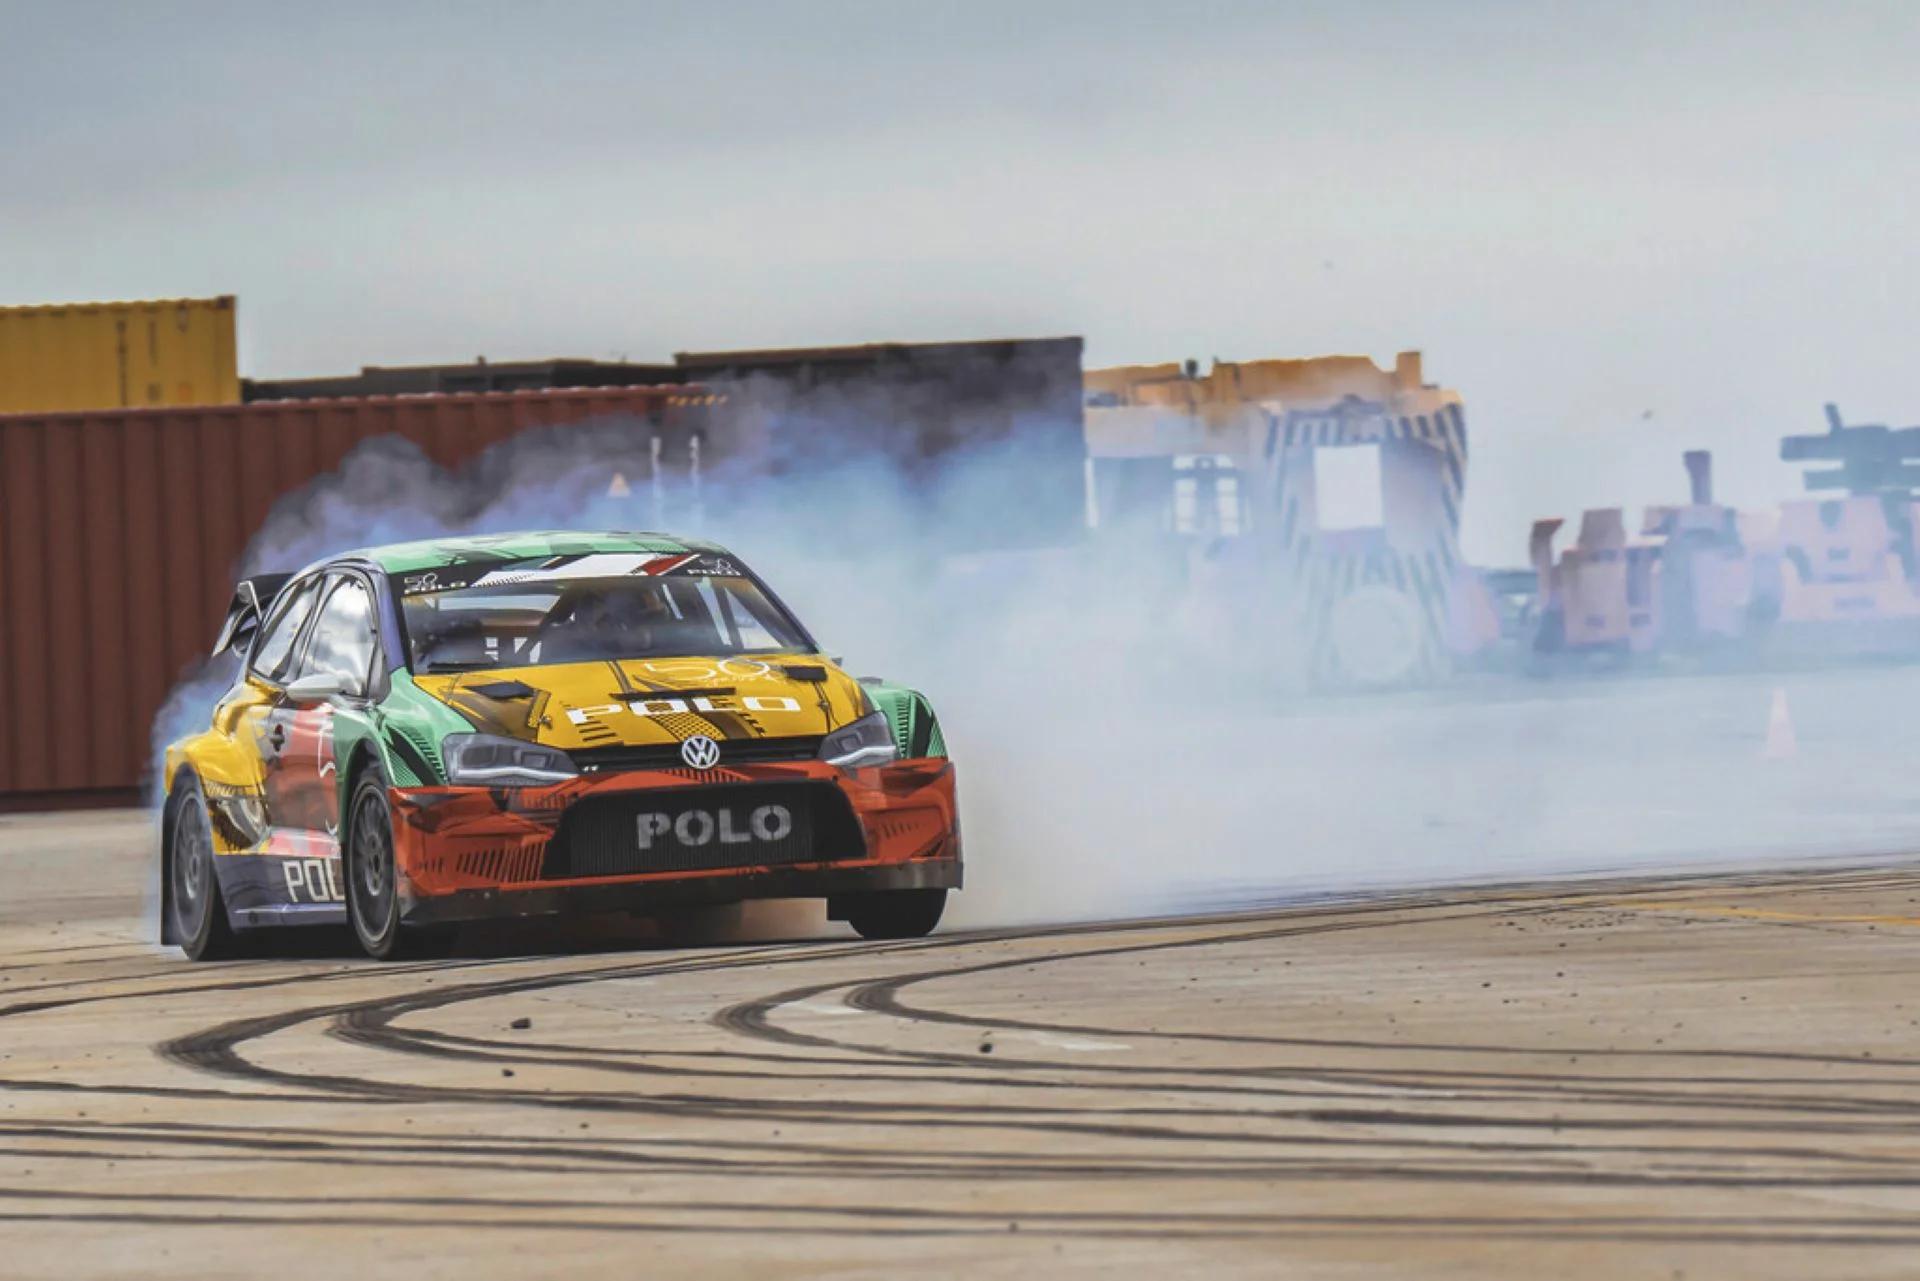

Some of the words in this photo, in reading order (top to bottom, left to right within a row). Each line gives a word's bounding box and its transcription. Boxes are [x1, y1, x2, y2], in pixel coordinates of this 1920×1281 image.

[566, 697, 801, 725] POLO
[636, 804, 792, 850] POLO
[282, 859, 345, 903] POL
